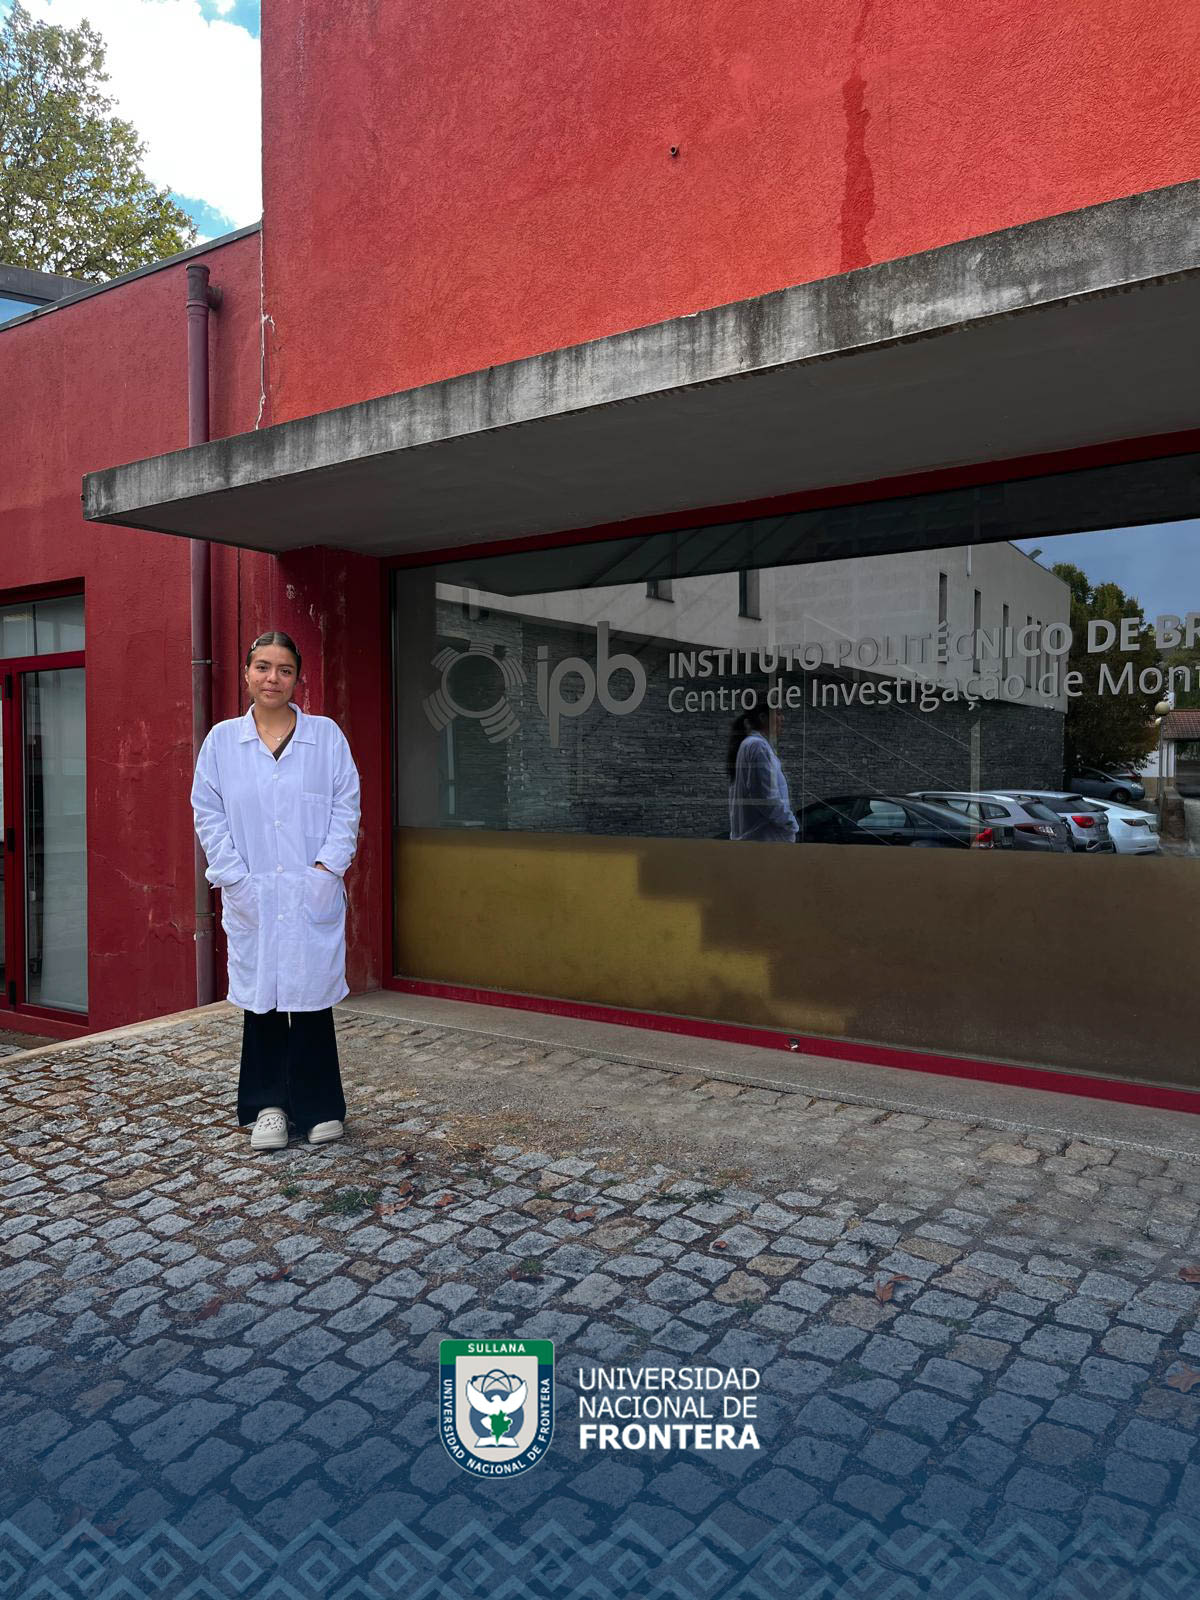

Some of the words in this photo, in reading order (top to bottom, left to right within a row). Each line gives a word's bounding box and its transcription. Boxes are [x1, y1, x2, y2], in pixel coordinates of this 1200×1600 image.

[669, 643, 824, 679] INSTITUTO
[833, 620, 1073, 669] POLITÉCNICO
[1088, 617, 1141, 653] DE
[537, 621, 647, 748] ipb
[668, 686, 757, 713] Centro
[767, 678, 801, 709] de
[812, 668, 1025, 713] Investigação
[1038, 662, 1083, 697] de
